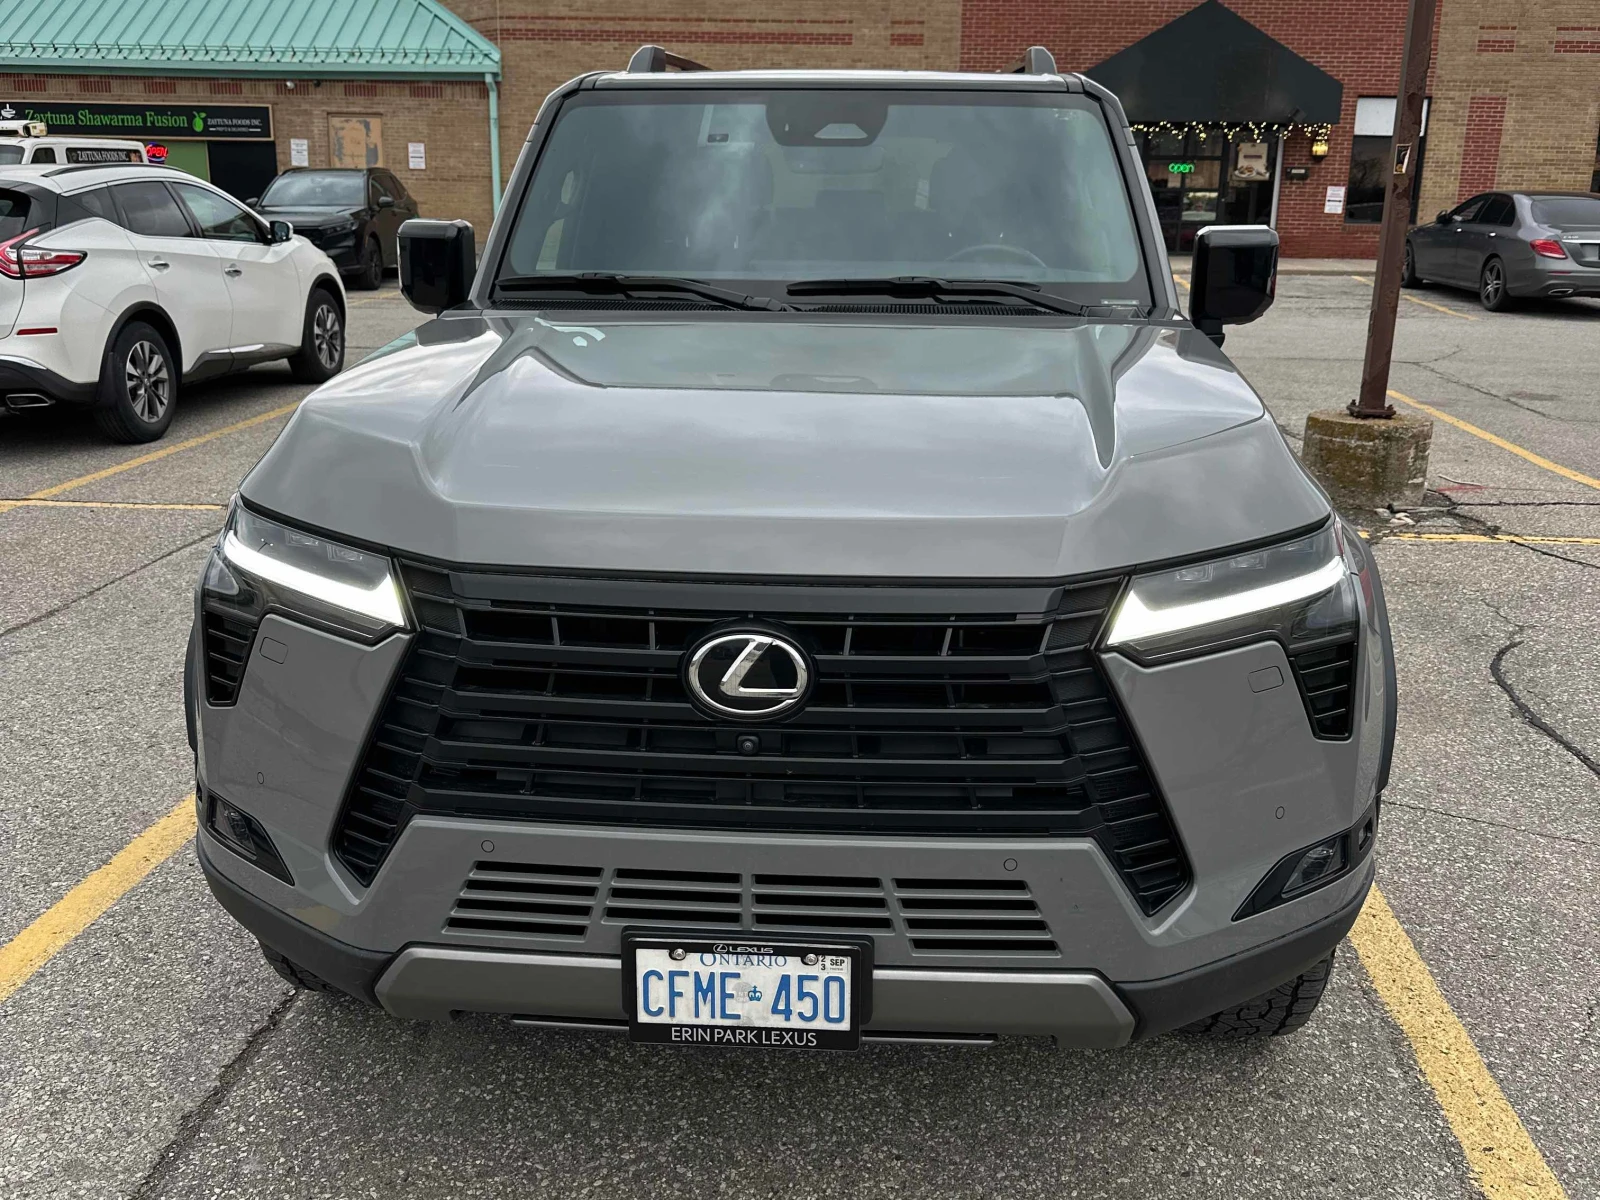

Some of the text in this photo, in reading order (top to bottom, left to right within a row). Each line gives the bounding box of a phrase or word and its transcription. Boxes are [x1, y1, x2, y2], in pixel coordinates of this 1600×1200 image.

[25, 109, 188, 127] Zaytuna Shawarma Fusion
[145, 145, 168, 157] OPEN
[1168, 163, 1195, 174] open
[729, 946, 774, 954] LEXUS
[700, 953, 787, 969] ONTARIO
[830, 958, 845, 966] SEP
[643, 970, 845, 1024] CFME 450
[671, 1027, 817, 1046] ERIN PARK LEXUS
